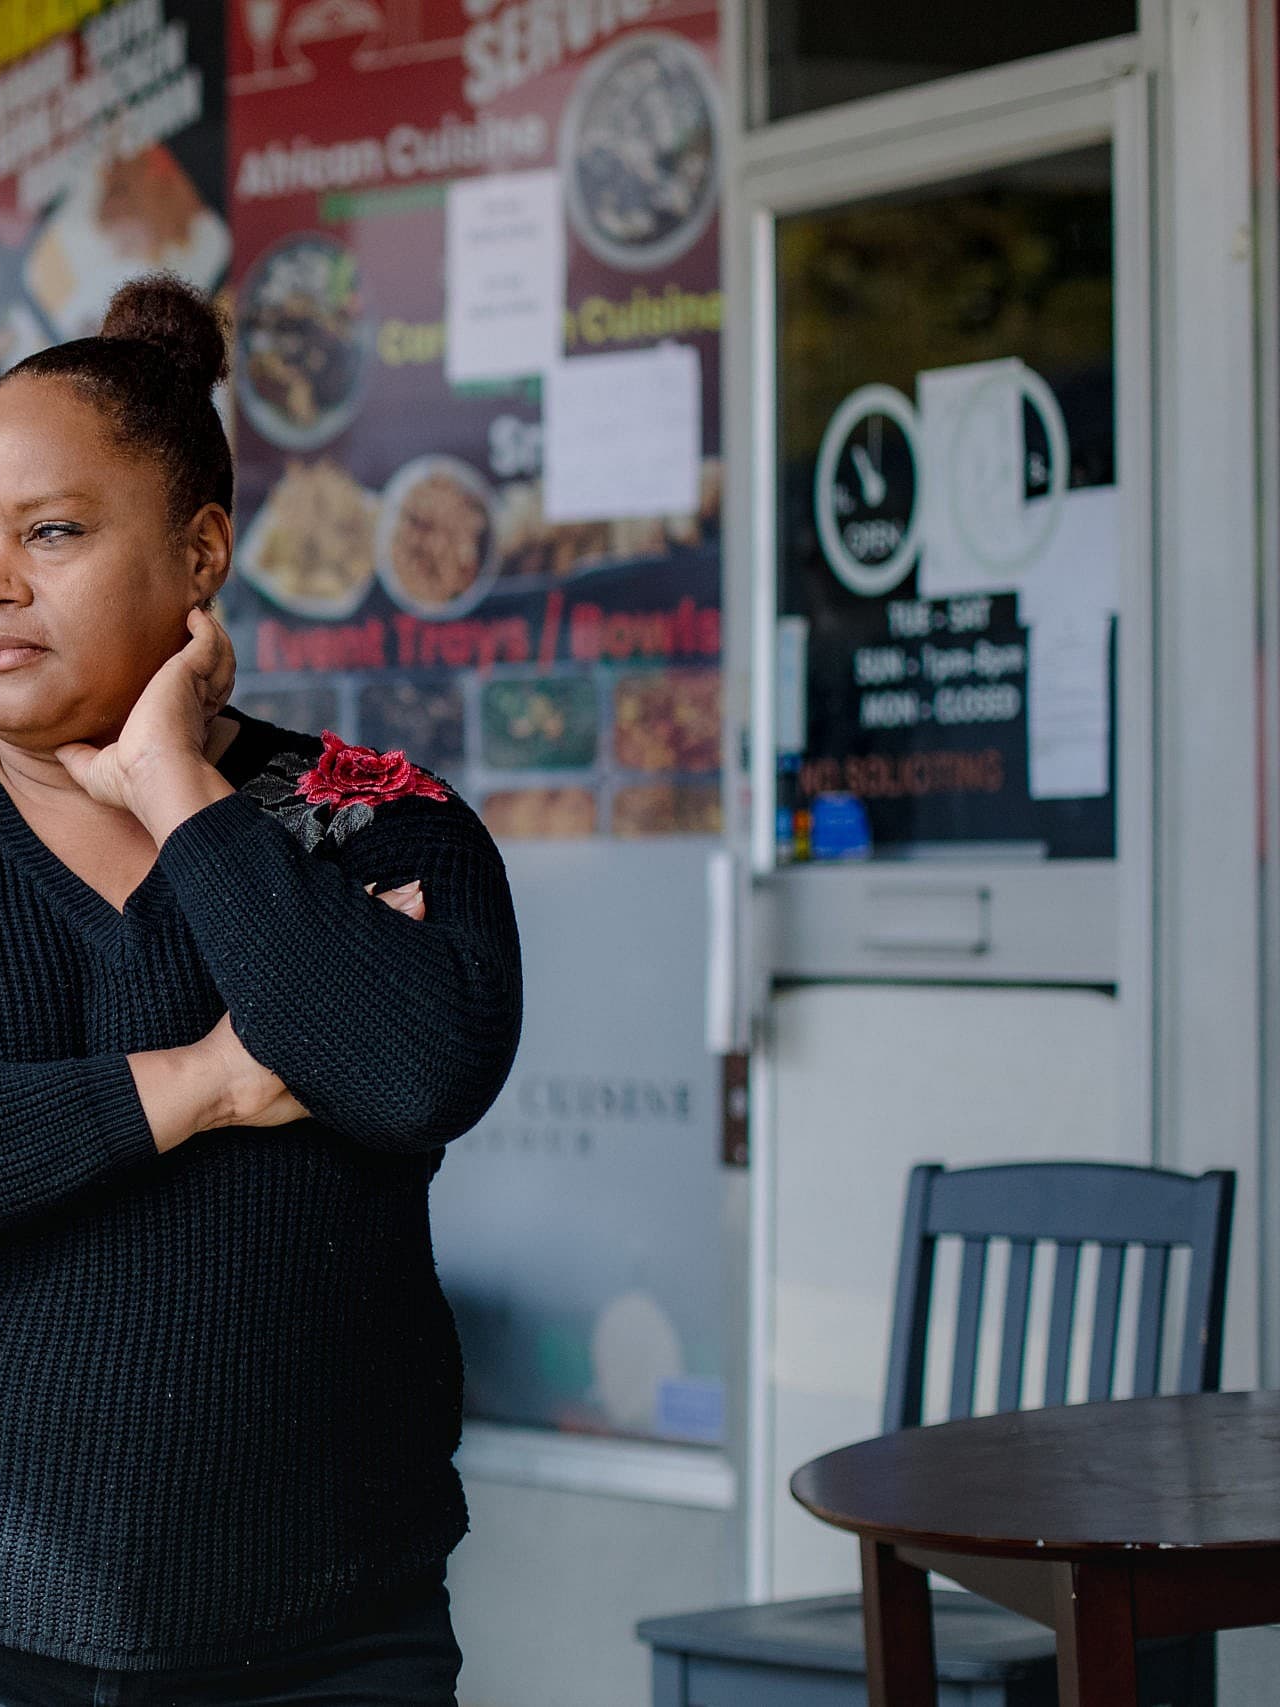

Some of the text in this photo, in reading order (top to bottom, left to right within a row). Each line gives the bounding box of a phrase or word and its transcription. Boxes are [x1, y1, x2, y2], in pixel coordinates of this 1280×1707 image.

[463, 0, 662, 105] SERVI
[236, 114, 547, 197] African Cuisine
[579, 284, 722, 346] Cuisine
[257, 616, 385, 672] Event
[394, 612, 529, 680] Trays
[570, 595, 721, 661] Bowls
[853, 646, 907, 687] SUN
[860, 689, 917, 729] MON
[933, 684, 1021, 725] CLOSED
[799, 749, 1006, 797] NO SOLICITING
[522, 1076, 690, 1122] CUISINE
